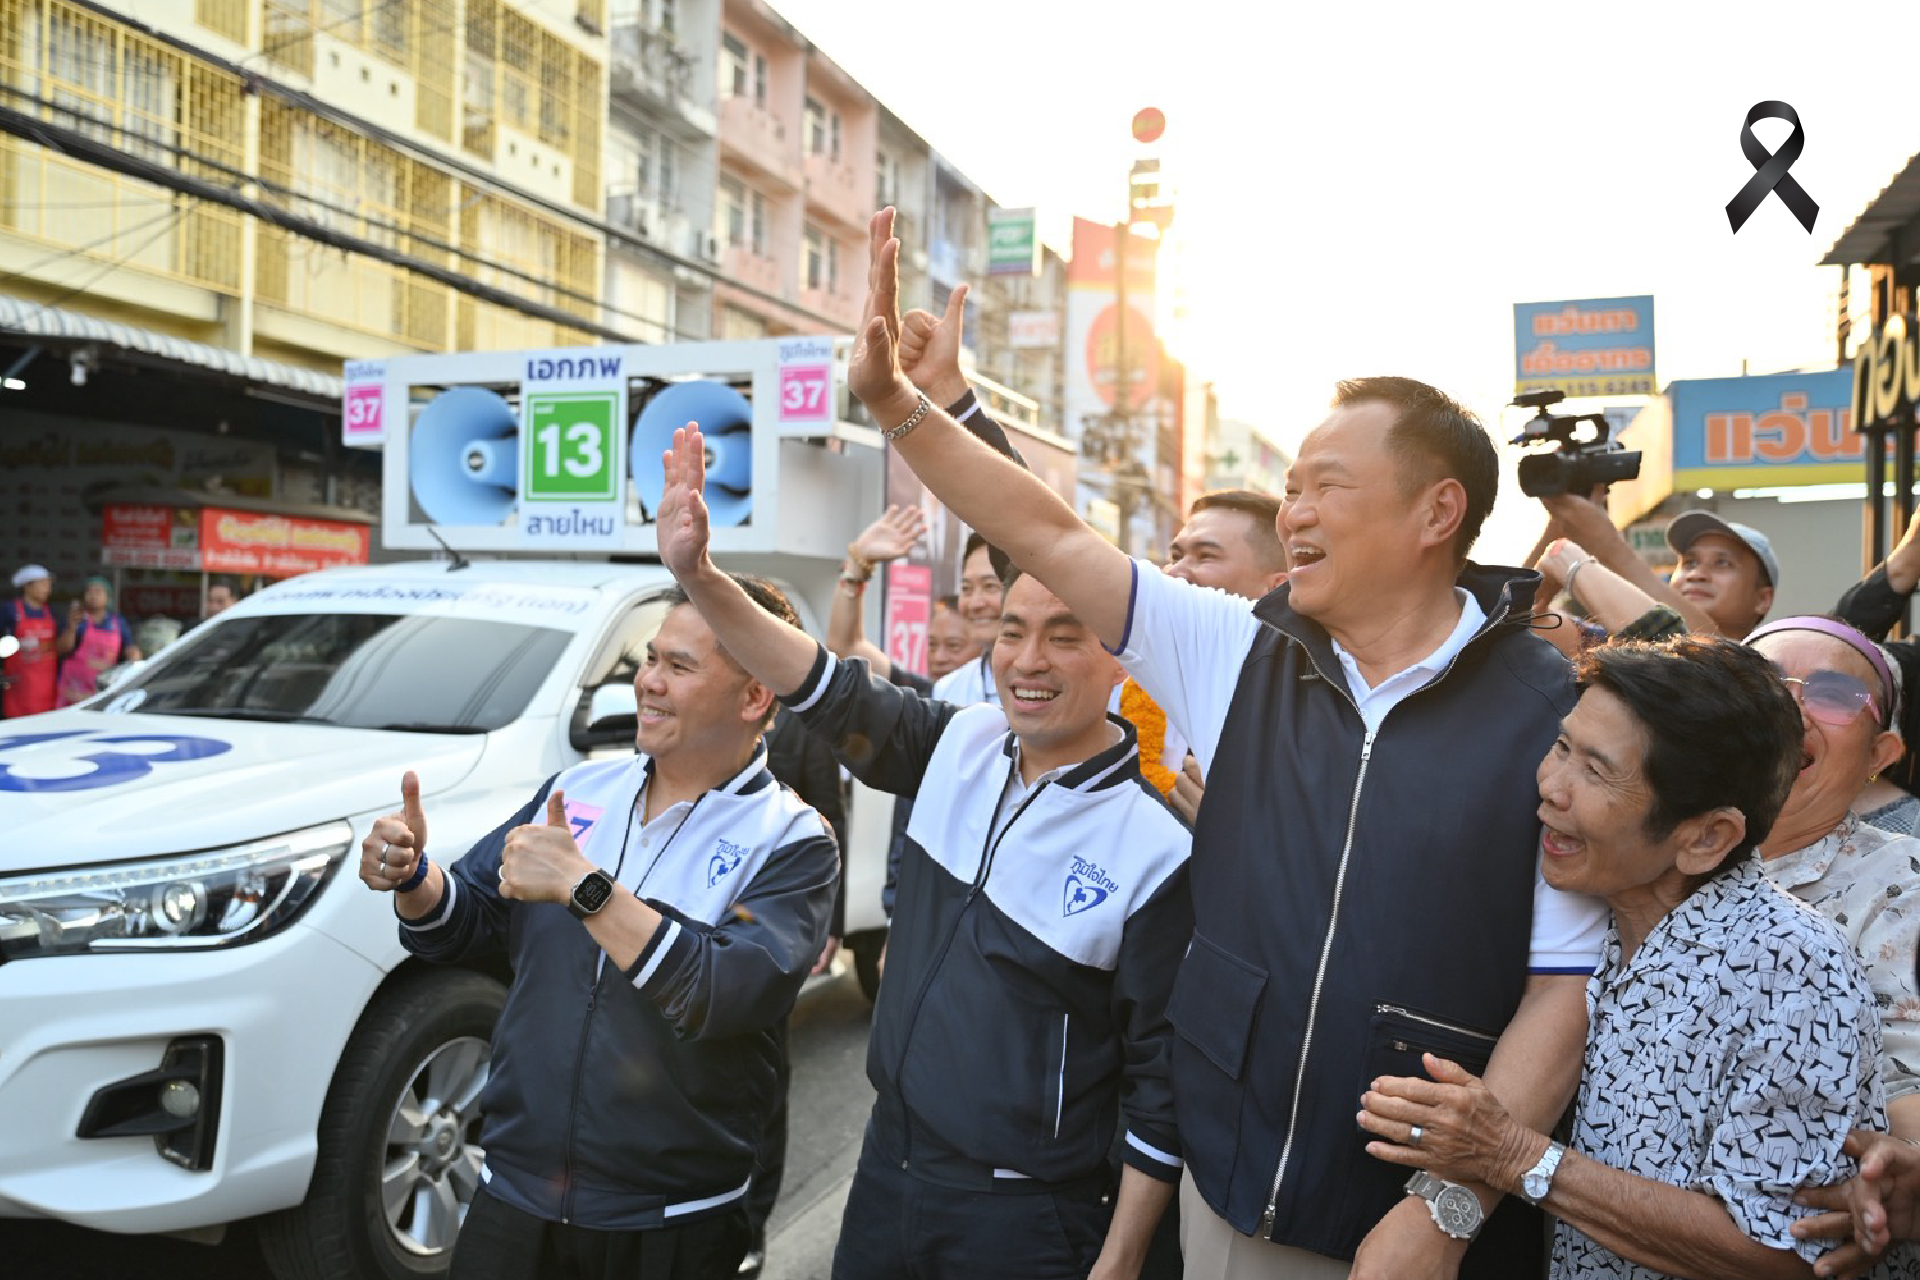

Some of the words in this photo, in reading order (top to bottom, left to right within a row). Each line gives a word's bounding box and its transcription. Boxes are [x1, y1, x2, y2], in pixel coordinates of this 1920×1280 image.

[1532, 306, 1637, 335] แว่นตา
[527, 357, 621, 381] เอกภพ
[784, 380, 826, 410] 37
[349, 398, 381, 424] 37
[536, 422, 603, 479] 13
[527, 508, 615, 536] สายไหม
[891, 620, 928, 674] 37
